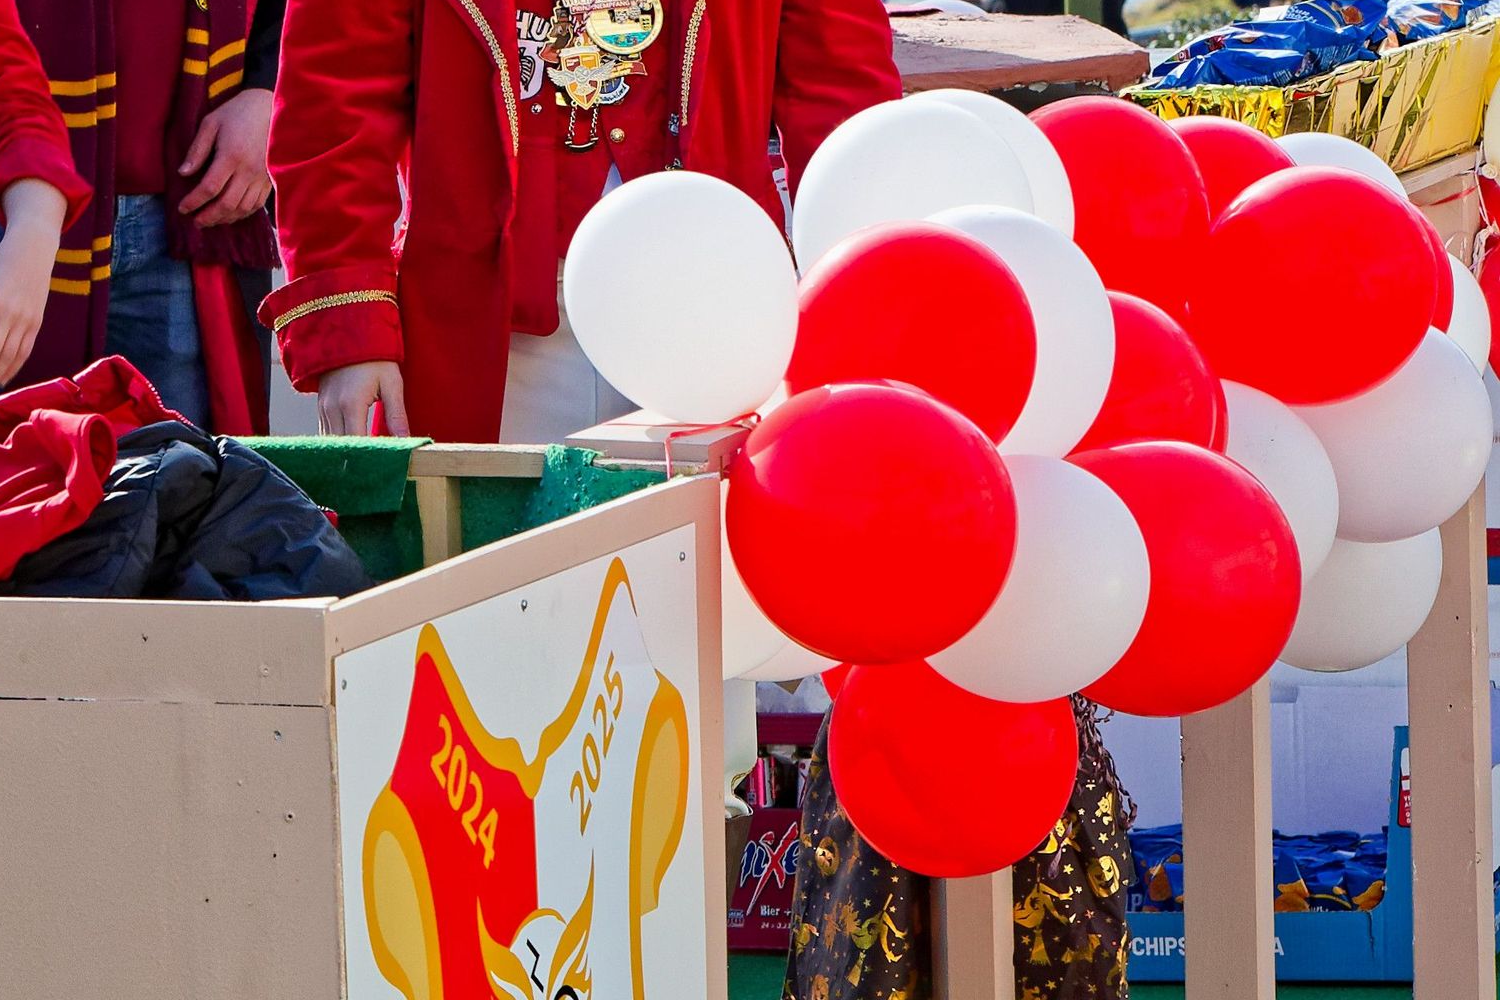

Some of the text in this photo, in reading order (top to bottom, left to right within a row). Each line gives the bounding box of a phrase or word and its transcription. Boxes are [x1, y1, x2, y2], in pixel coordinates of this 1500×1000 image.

[516, 9, 550, 41] HU
[570, 650, 623, 836] 2025
[430, 713, 498, 870] 2024
[760, 905, 780, 916] Bier
